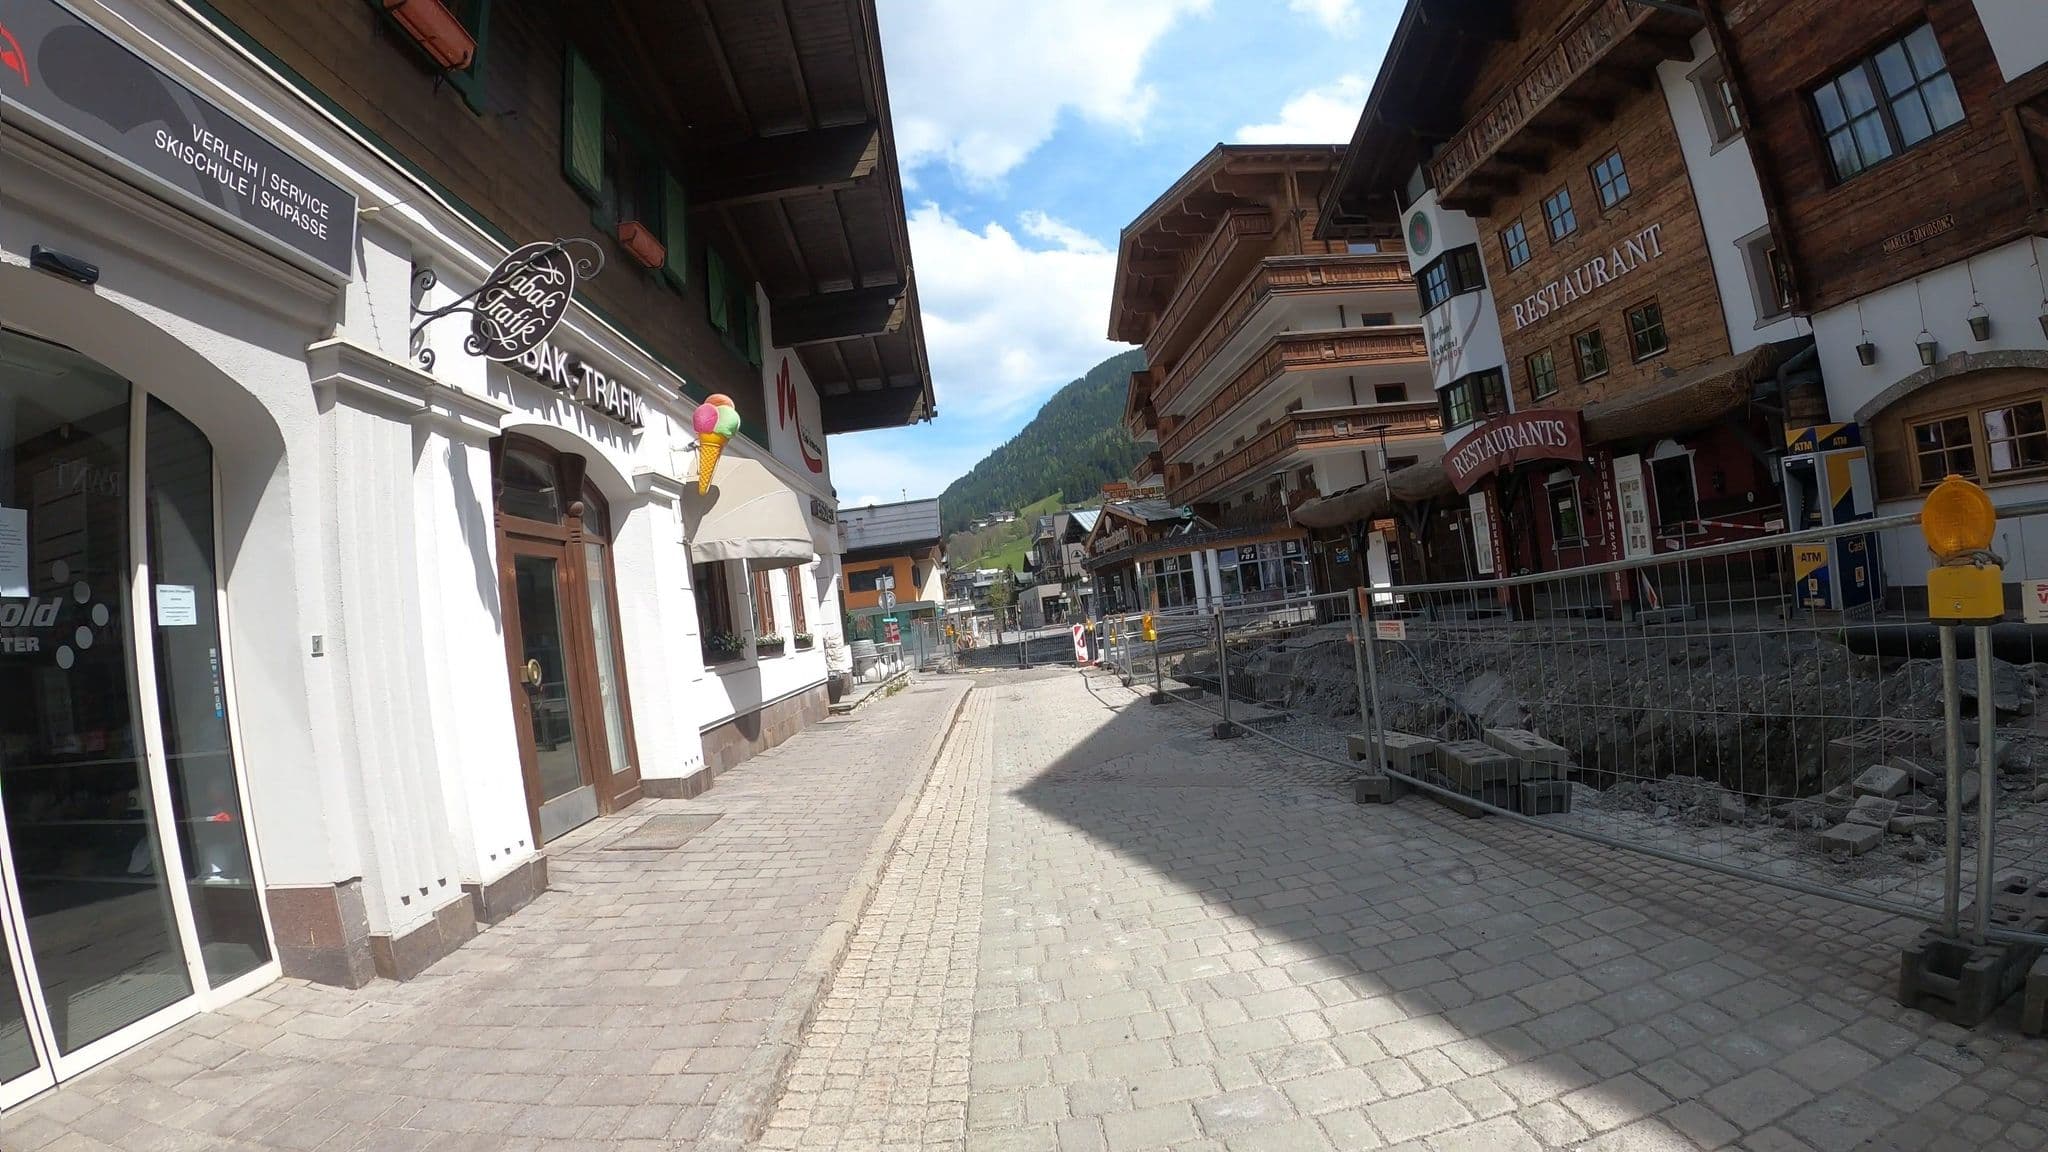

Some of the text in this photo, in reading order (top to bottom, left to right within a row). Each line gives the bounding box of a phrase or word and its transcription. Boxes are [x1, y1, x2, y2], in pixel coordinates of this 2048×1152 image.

[154, 129, 328, 241] SKISCHULE SKIPÄSSE
[191, 123, 330, 220] VERLEIH SERVICE
[498, 258, 565, 318] Tabak
[1511, 223, 1665, 330] RESTAURANT
[478, 287, 545, 345] Trafik
[517, 341, 645, 426] BAK-TRAFIK
[1452, 420, 1568, 479] RESTAURANTS
[1794, 440, 1813, 452] ATM
[1832, 436, 1848, 447] ATM
[1599, 450, 1622, 591] FUHRMANNSSTBE
[1801, 551, 1822, 563] ATM
[0, 596, 63, 627] old
